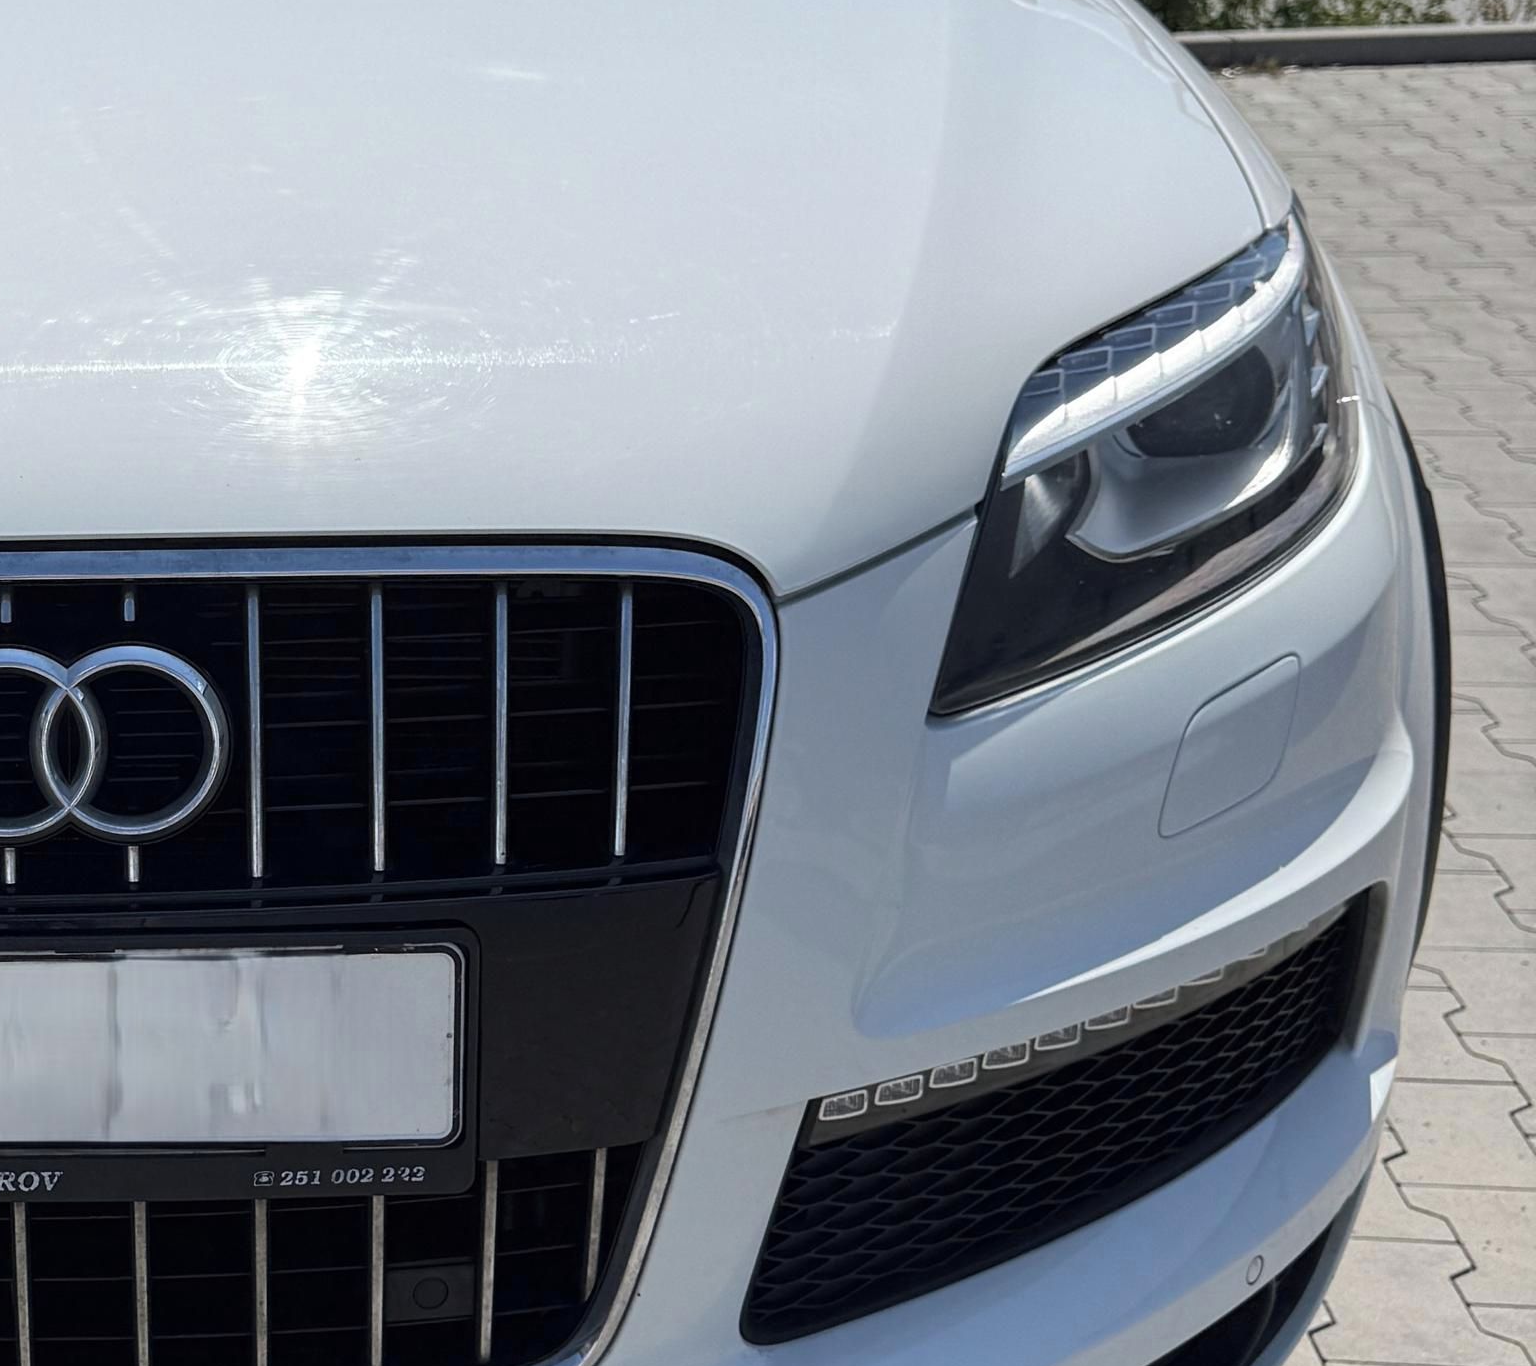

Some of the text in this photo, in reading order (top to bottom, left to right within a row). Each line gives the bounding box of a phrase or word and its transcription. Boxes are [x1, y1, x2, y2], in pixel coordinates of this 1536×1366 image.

[280, 1166, 426, 1186] 251 002 222
